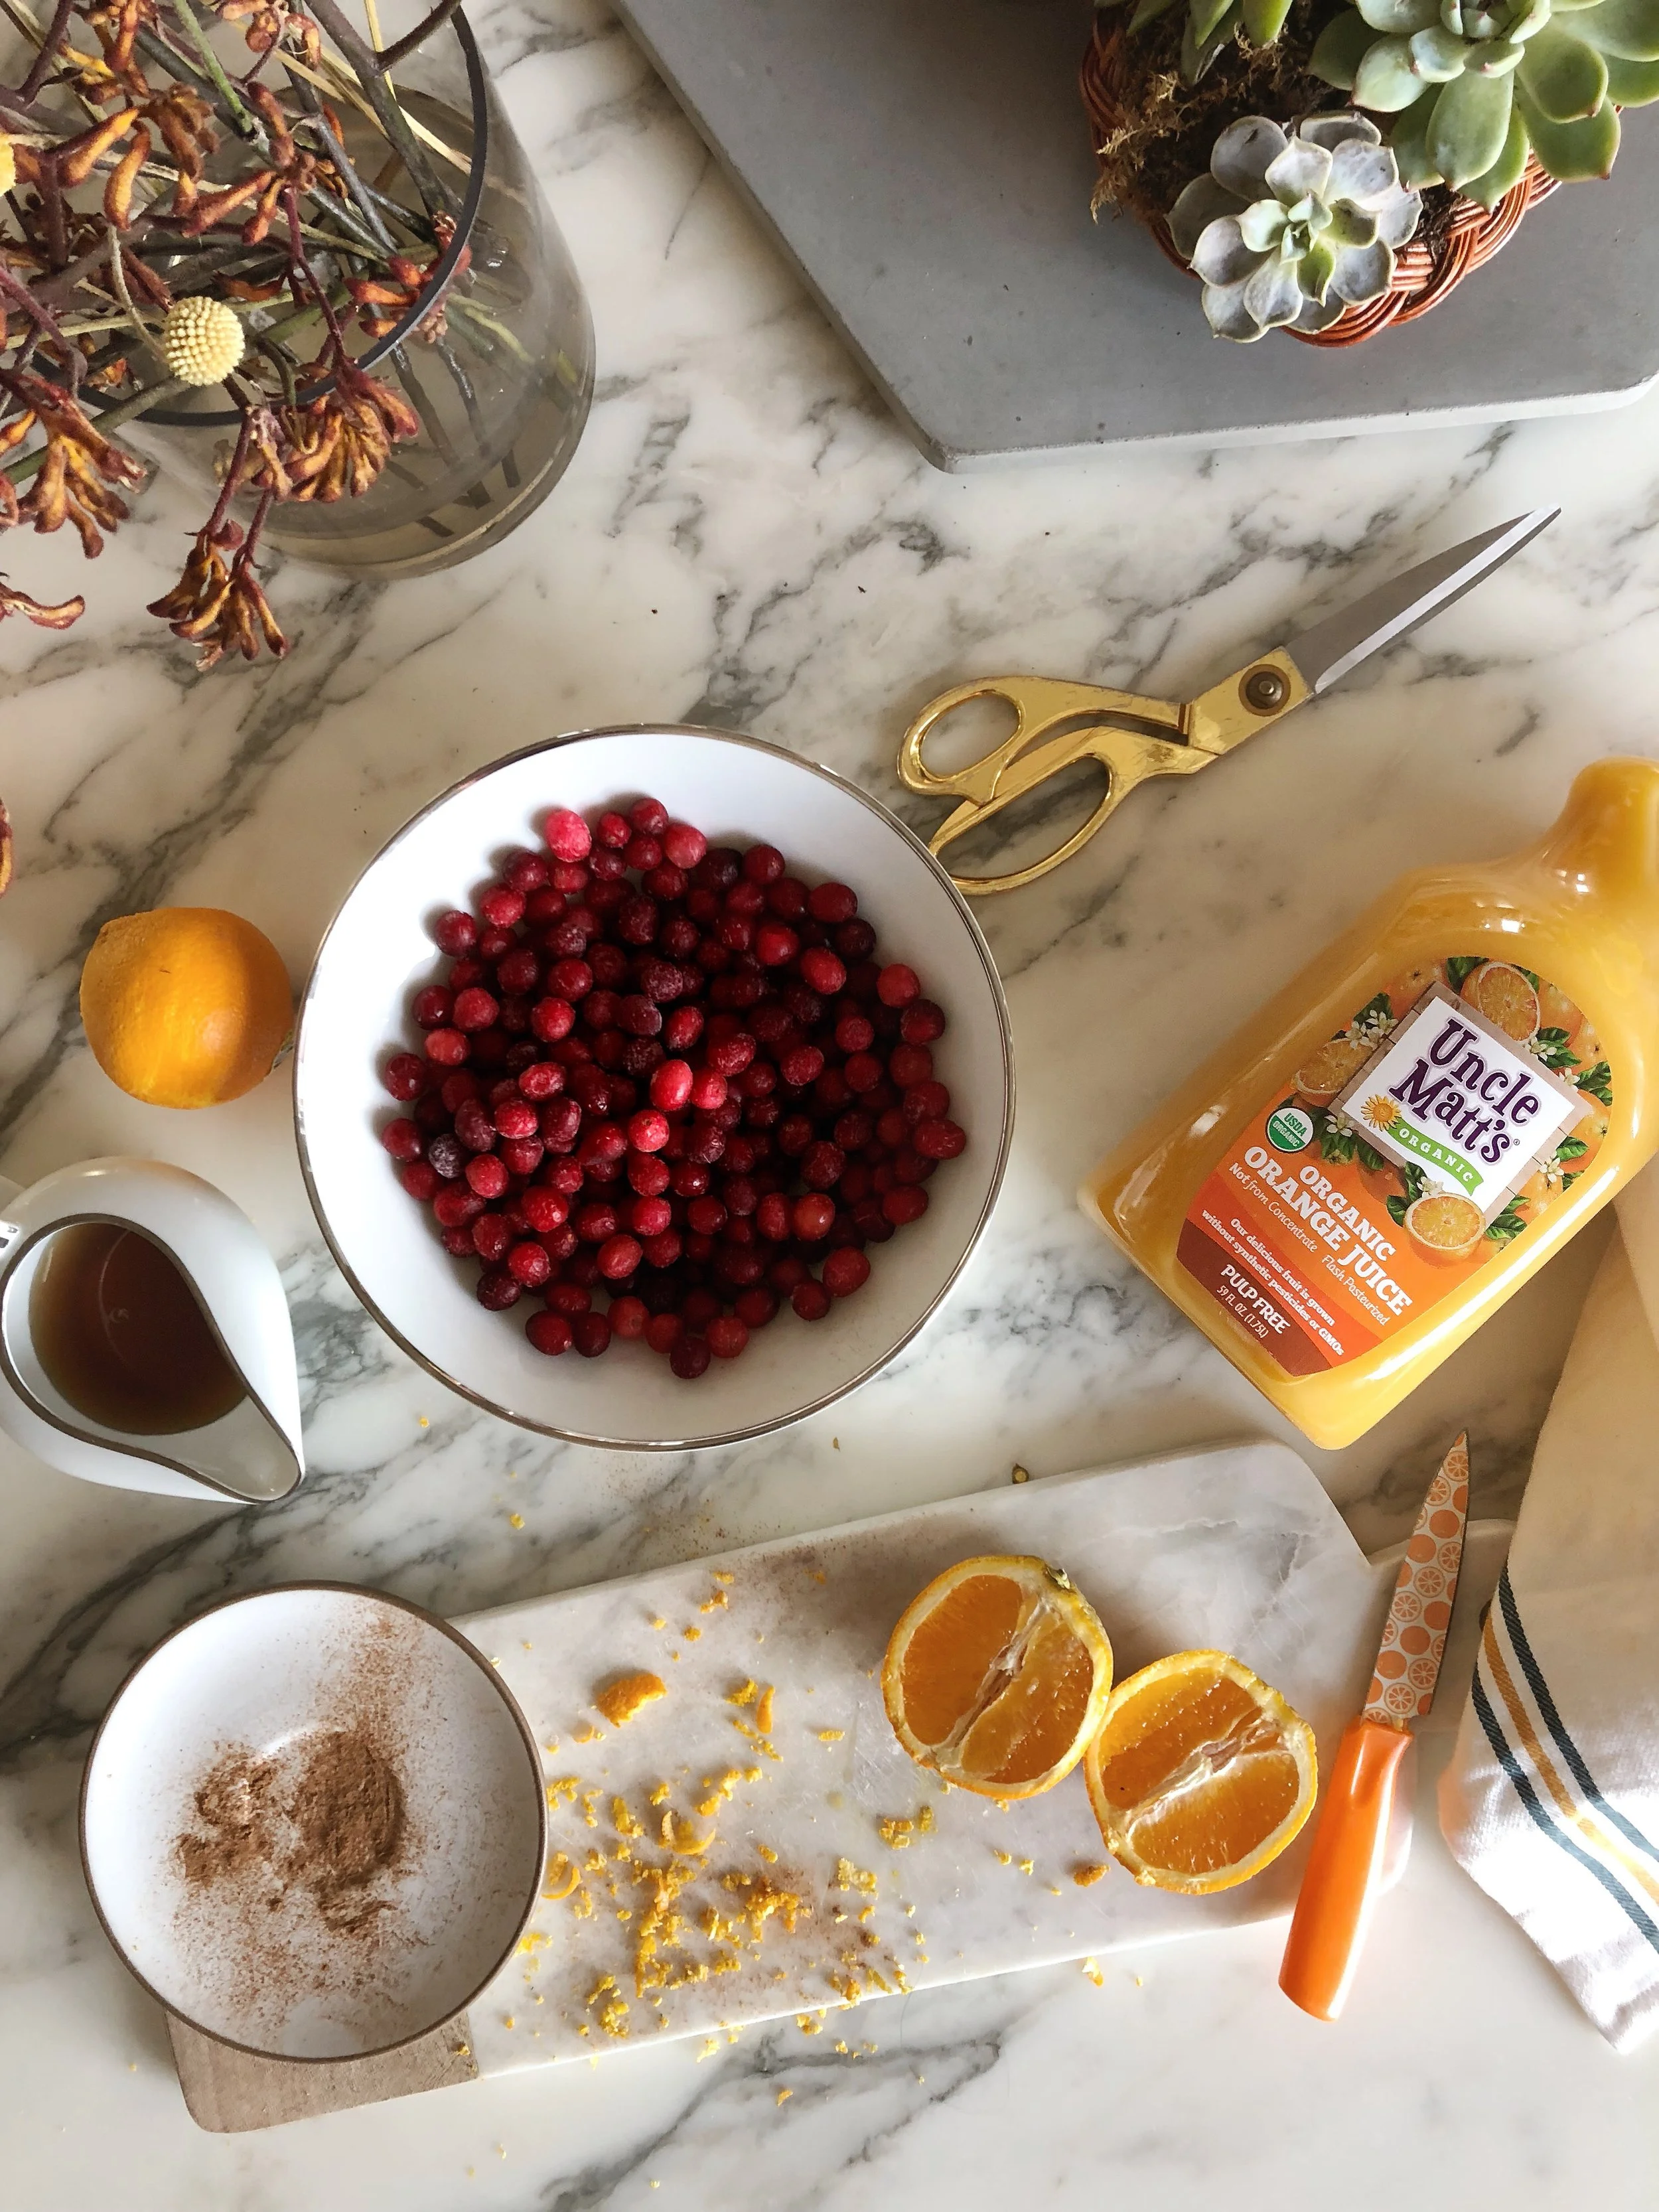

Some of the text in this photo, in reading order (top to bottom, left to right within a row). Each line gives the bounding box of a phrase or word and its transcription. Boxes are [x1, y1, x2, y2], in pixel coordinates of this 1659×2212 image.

[1388, 1059, 1510, 1163] Matt's
[1430, 1018, 1539, 1124] Uncle
[1272, 1120, 1300, 1147] ORGANIC
[1283, 1112, 1307, 1137] USDA
[1399, 1128, 1474, 1181] ORGANIC
[1229, 1162, 1319, 1252] Not from Concentrate
[1244, 1146, 1413, 1315] ORANGE JUICE
[1299, 1165, 1396, 1262] ORGANIC
[1202, 1210, 1344, 1356] without synthetic pesticides or GMOs
[1216, 1285, 1229, 1296] 59
[1244, 1312, 1269, 1339] (1.75L)
[1220, 1264, 1291, 1334] PULP FREE
[1230, 1218, 1336, 1327] Our delicious fruit is grown
[1321, 1254, 1391, 1326] Flash Pasteurized
